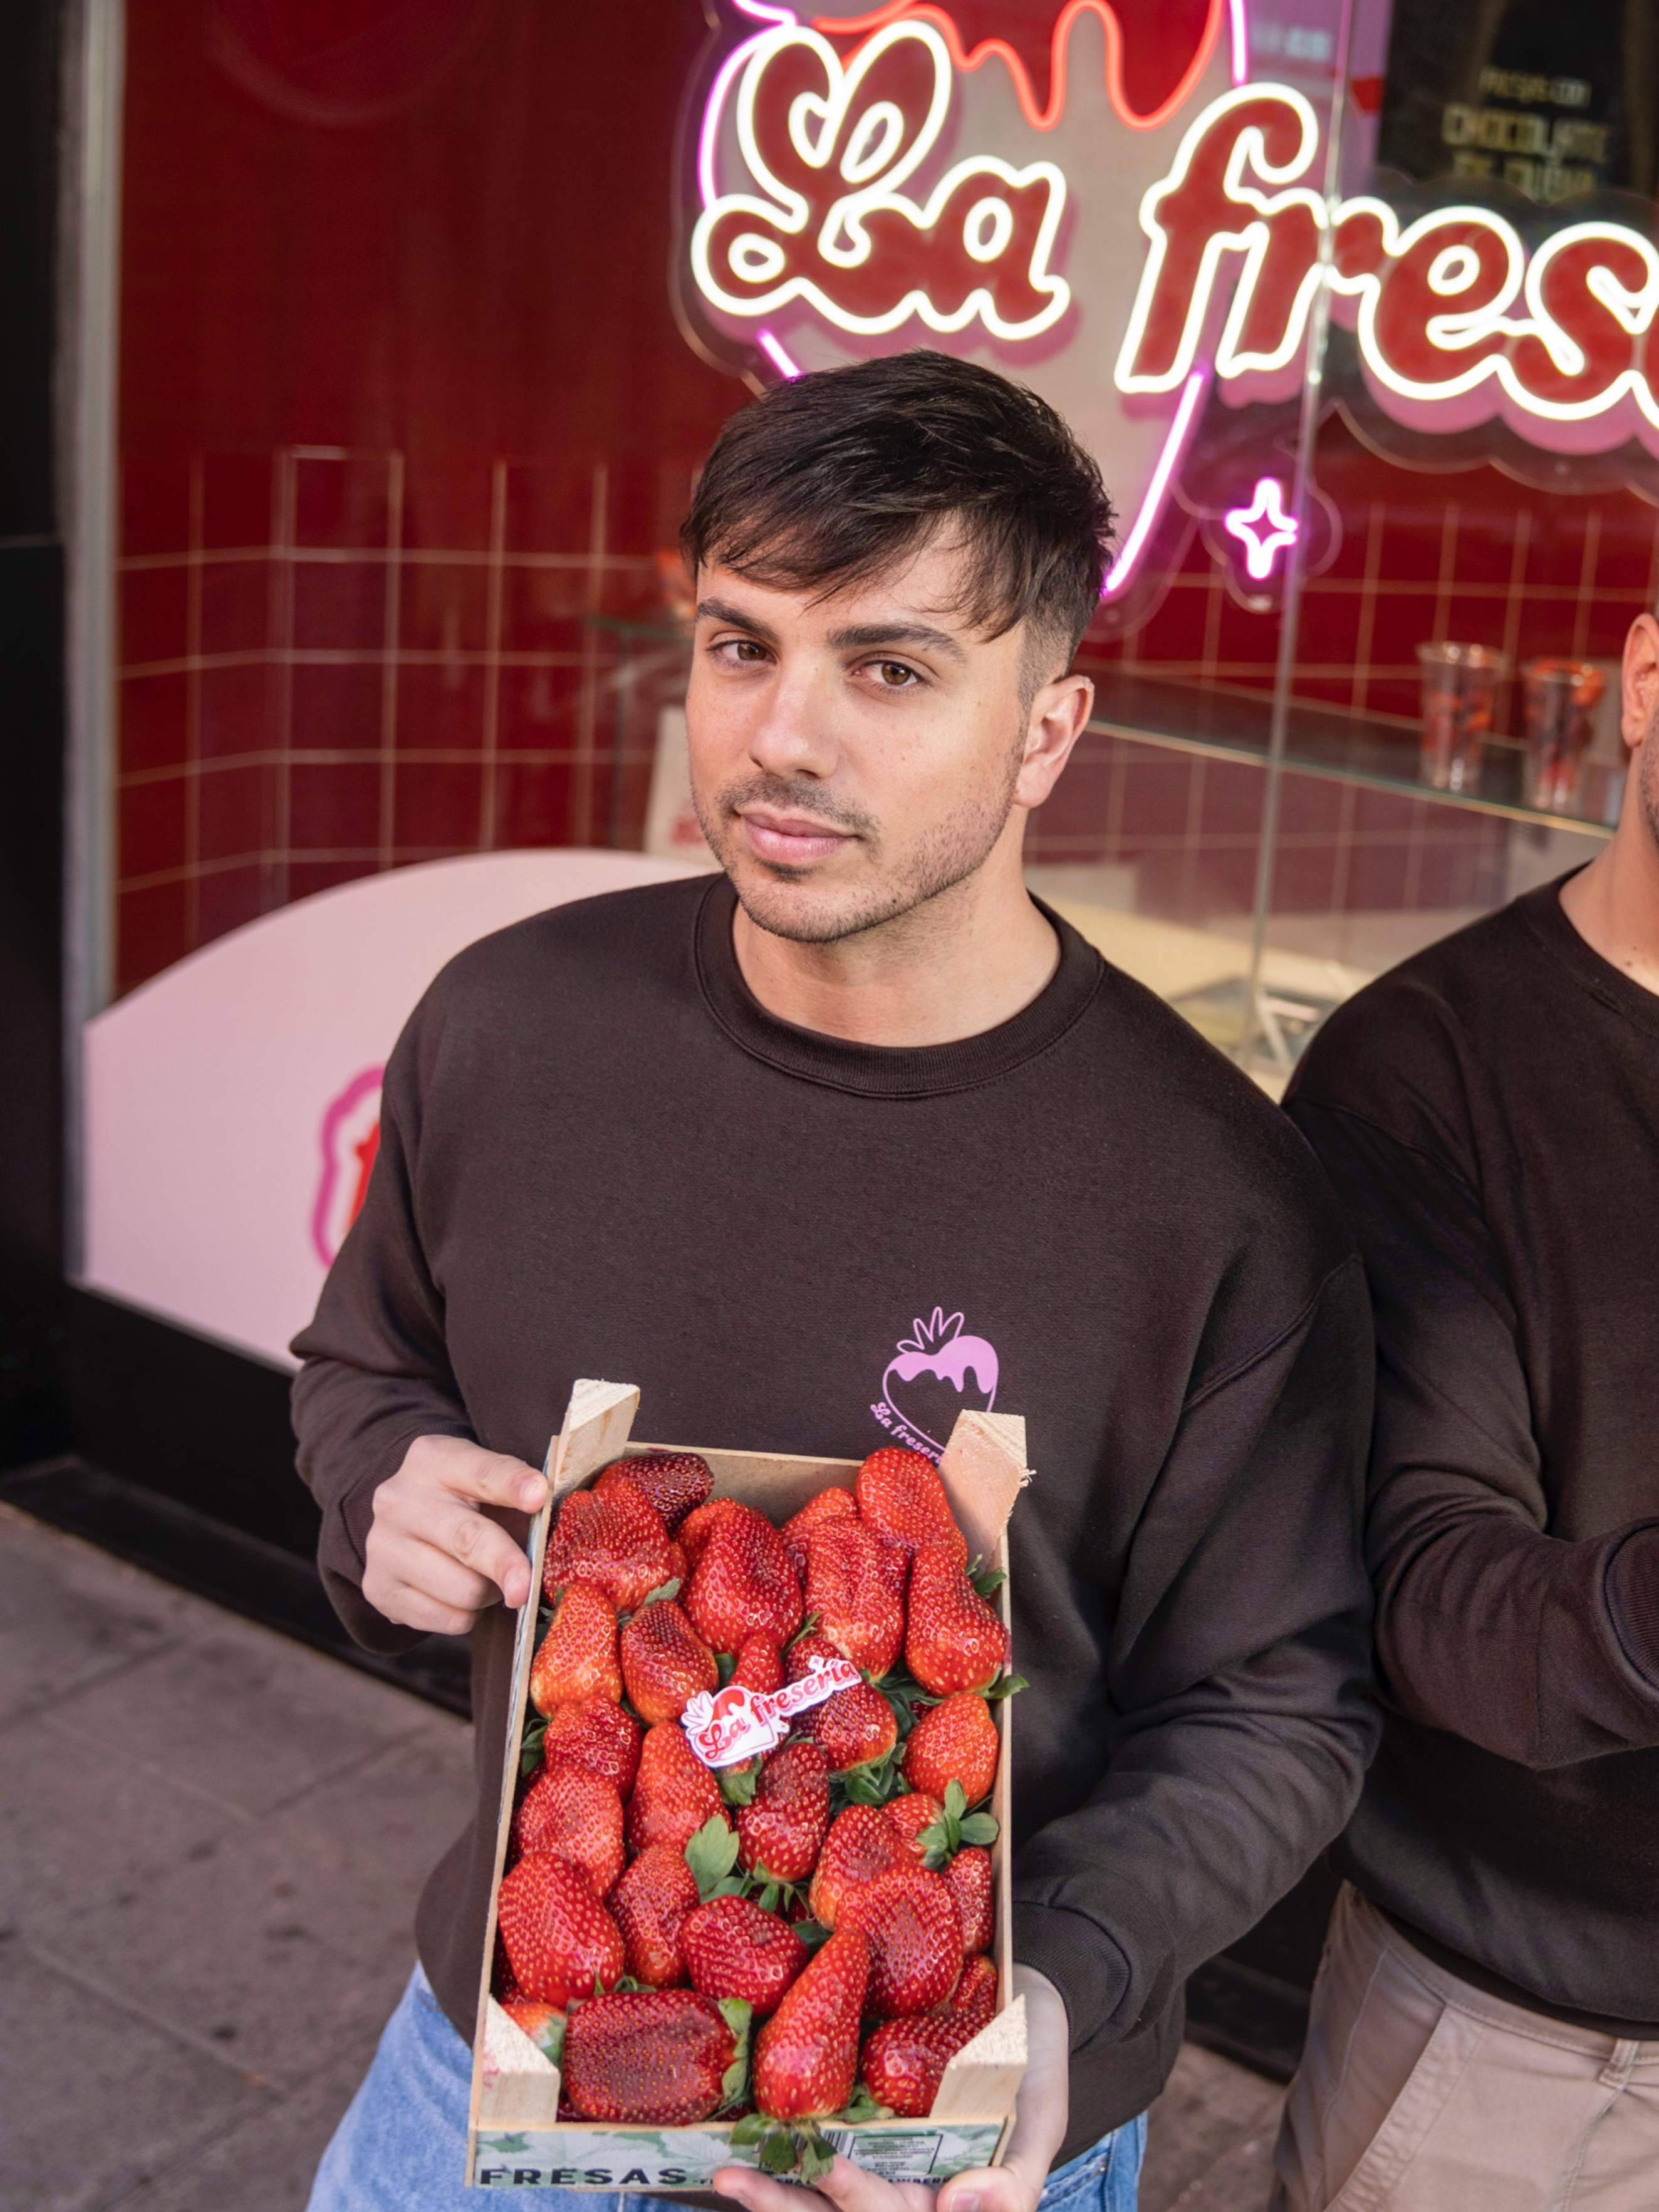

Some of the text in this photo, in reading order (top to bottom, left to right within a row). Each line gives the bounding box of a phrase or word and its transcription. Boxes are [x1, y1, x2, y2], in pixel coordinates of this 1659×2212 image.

[692, 20, 1659, 437] La fres
[870, 1401, 892, 1428] La
[698, 1718, 747, 1760] La
[480, 2168, 687, 2184] FRESAS
